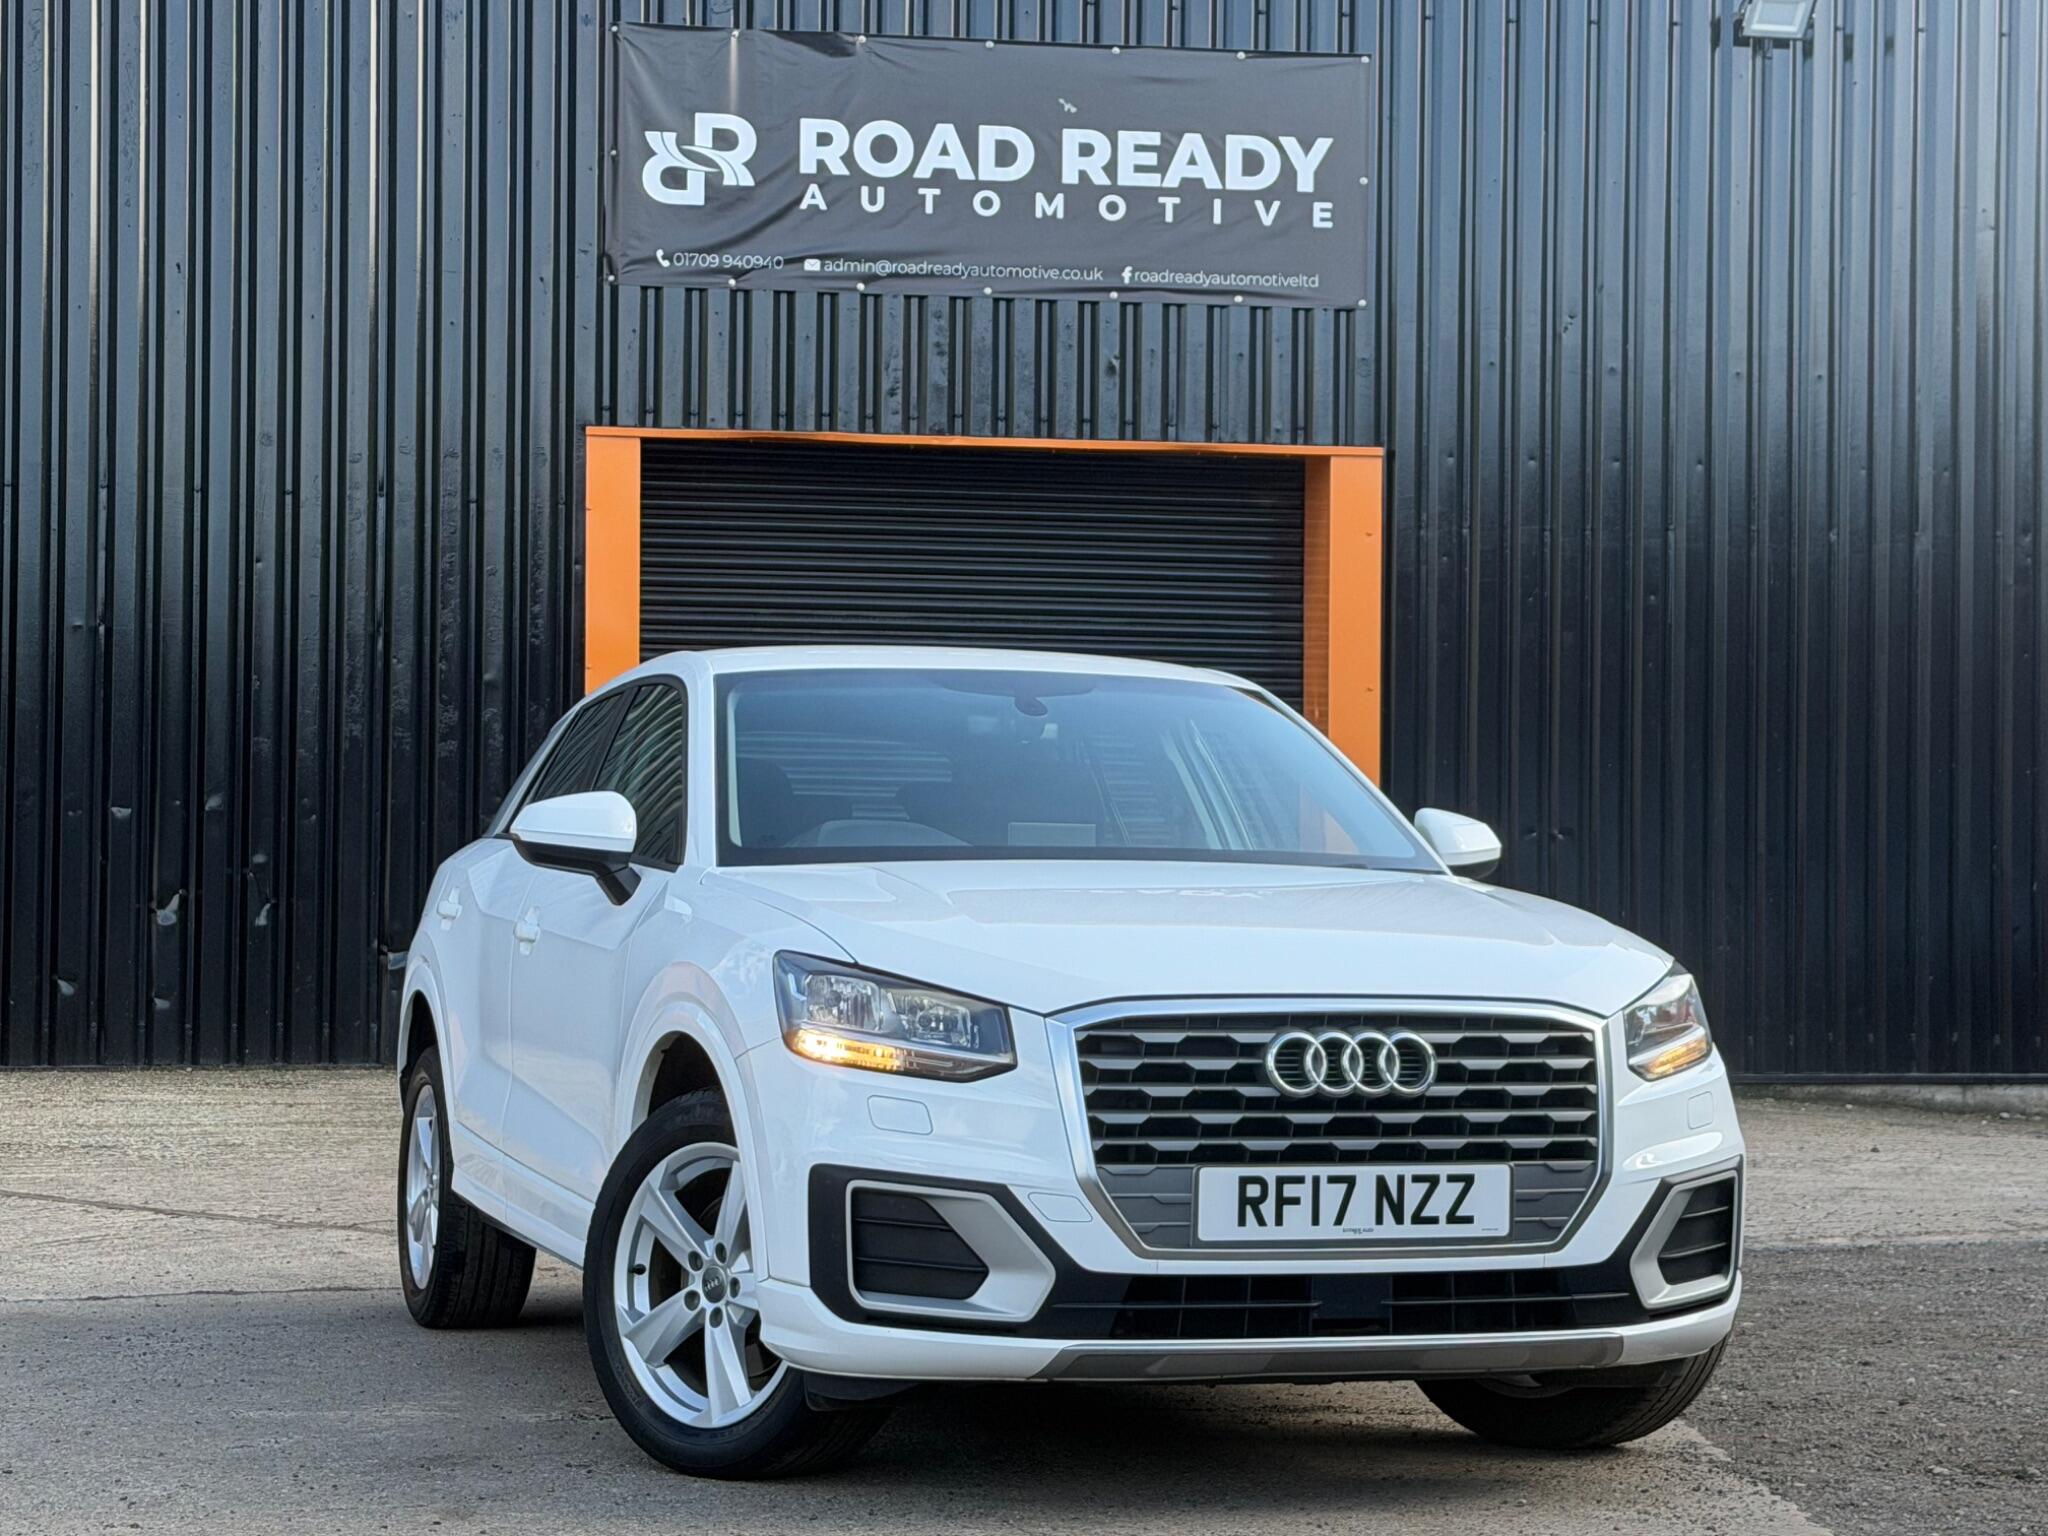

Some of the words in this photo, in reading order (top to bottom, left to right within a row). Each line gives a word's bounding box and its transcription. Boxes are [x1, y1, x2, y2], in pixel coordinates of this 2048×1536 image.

[799, 117, 1036, 182] ROAD
[1061, 128, 1334, 193] READY
[799, 183, 1334, 228] AUTOMOTIVE
[673, 252, 719, 268] 01709
[722, 254, 784, 270] 940940
[823, 259, 1104, 281] admin@roadreadyautomotive.co.uk
[1134, 269, 1319, 288] roadreadyautomotiveltd
[1237, 1174, 1357, 1227] RF17
[1375, 1173, 1475, 1226] NZZ
